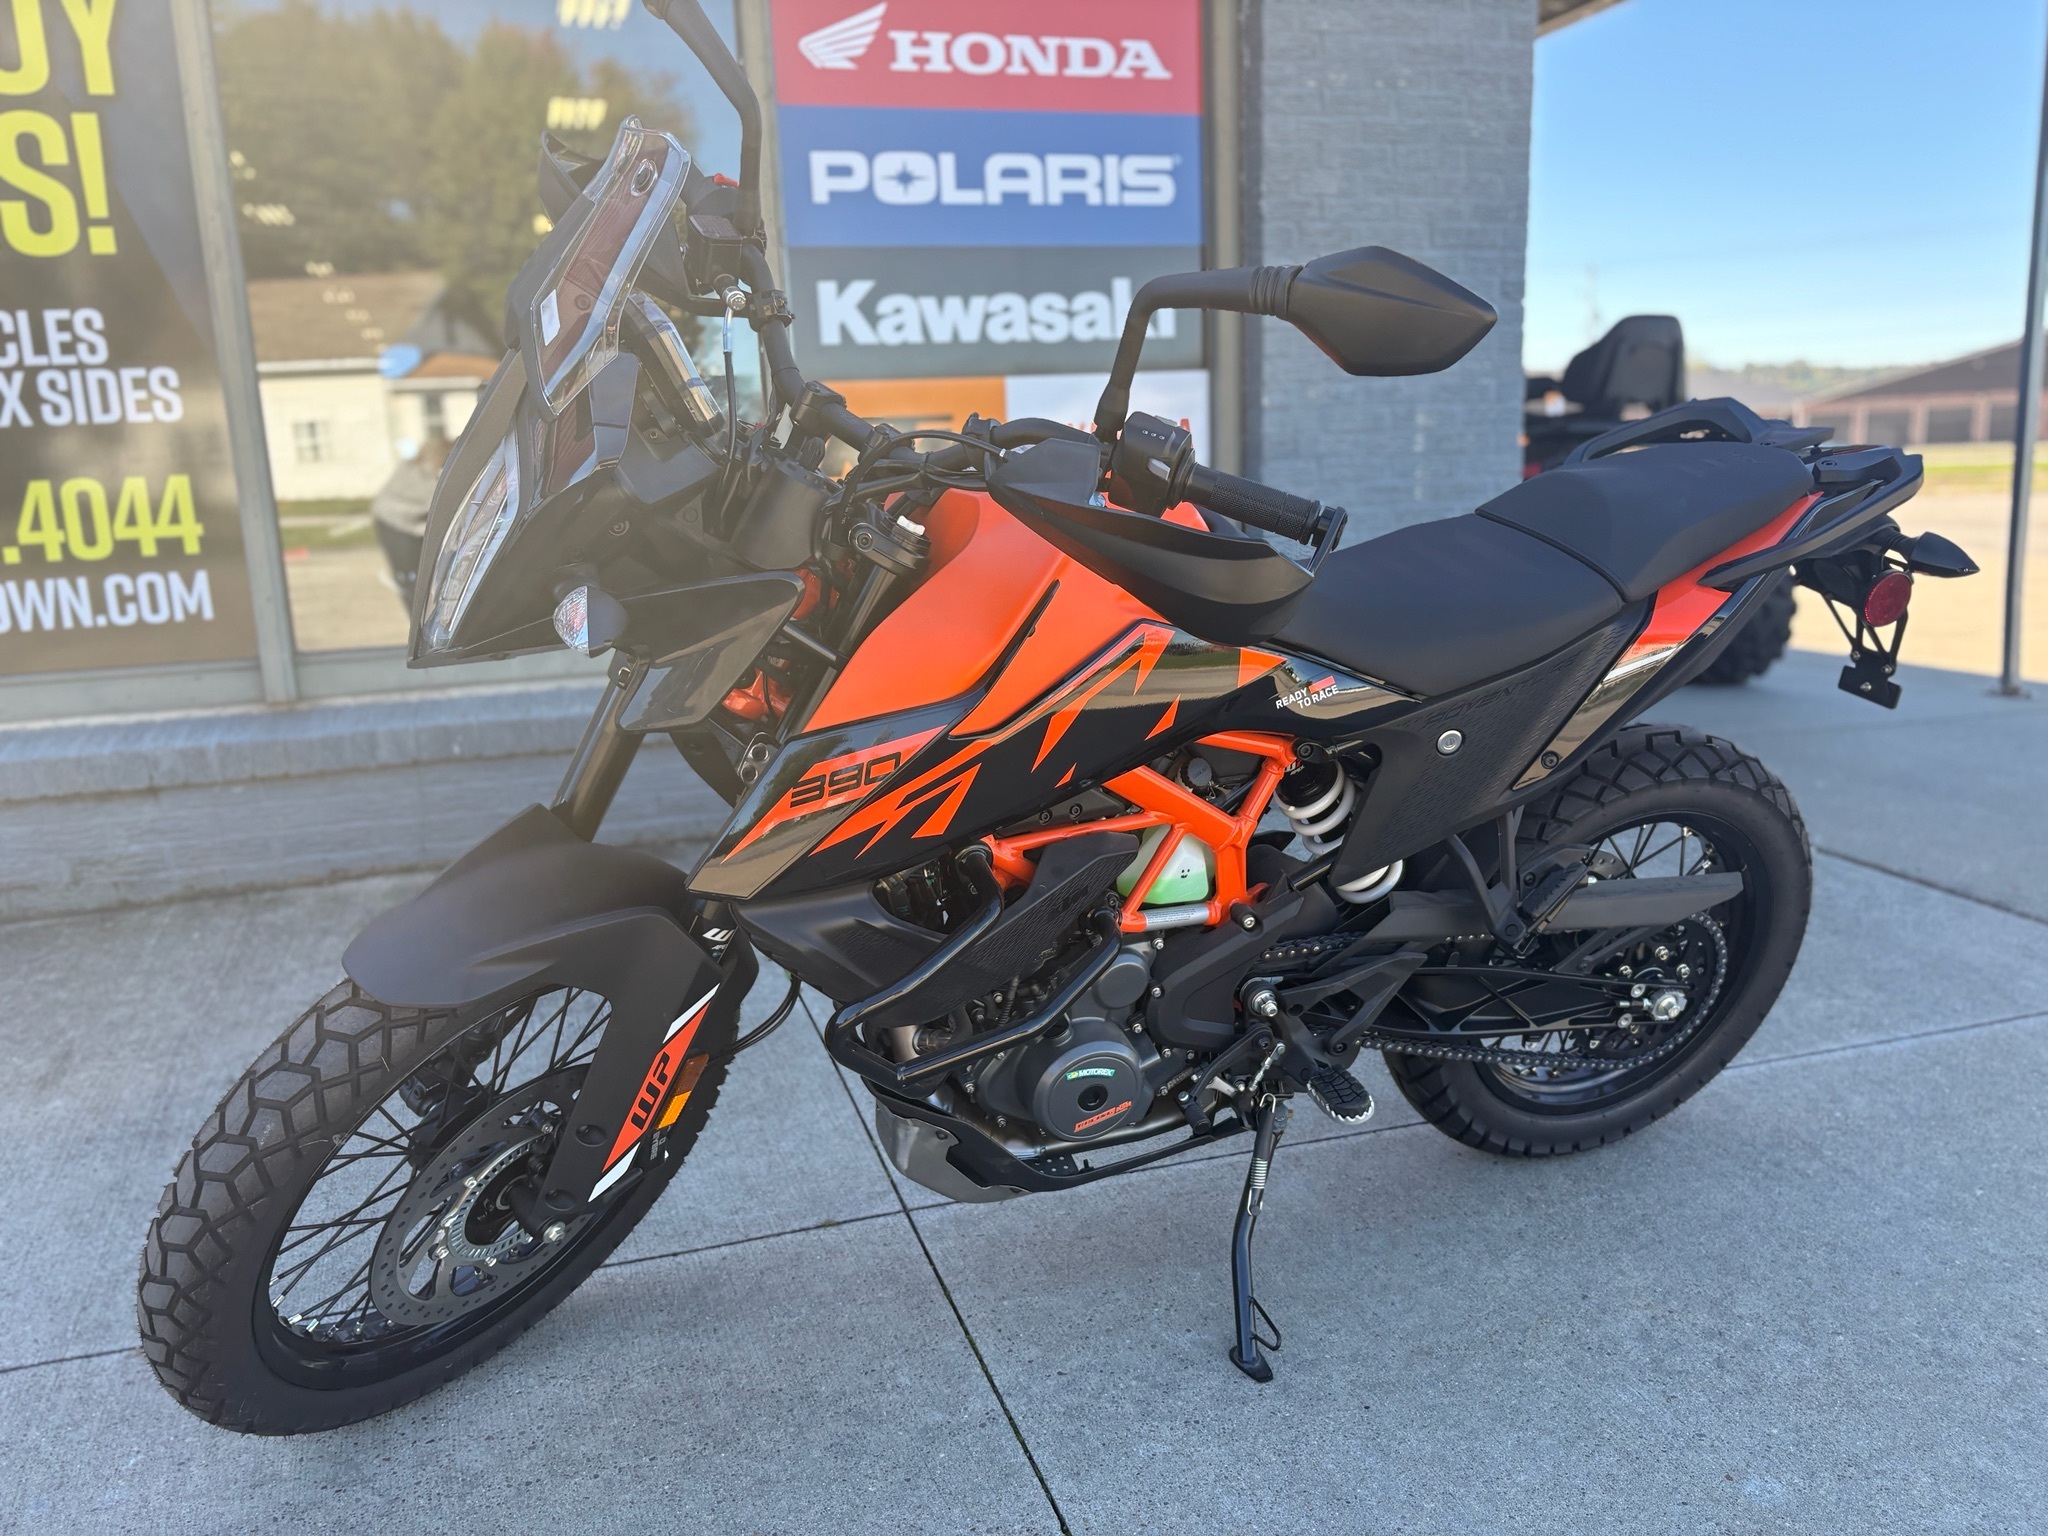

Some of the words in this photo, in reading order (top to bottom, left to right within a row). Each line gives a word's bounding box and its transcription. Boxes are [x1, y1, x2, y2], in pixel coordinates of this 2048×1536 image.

[888, 30, 1172, 80] HONDA
[809, 150, 1176, 207] POLARIS
[36, 366, 184, 427] SIDES
[1275, 687, 1308, 709] READY
[1297, 697, 1312, 709] TO
[1312, 685, 1340, 704] RACE
[790, 752, 901, 808] 390
[631, 1051, 671, 1131] WP
[1078, 1067, 1113, 1077] MOTOREX
